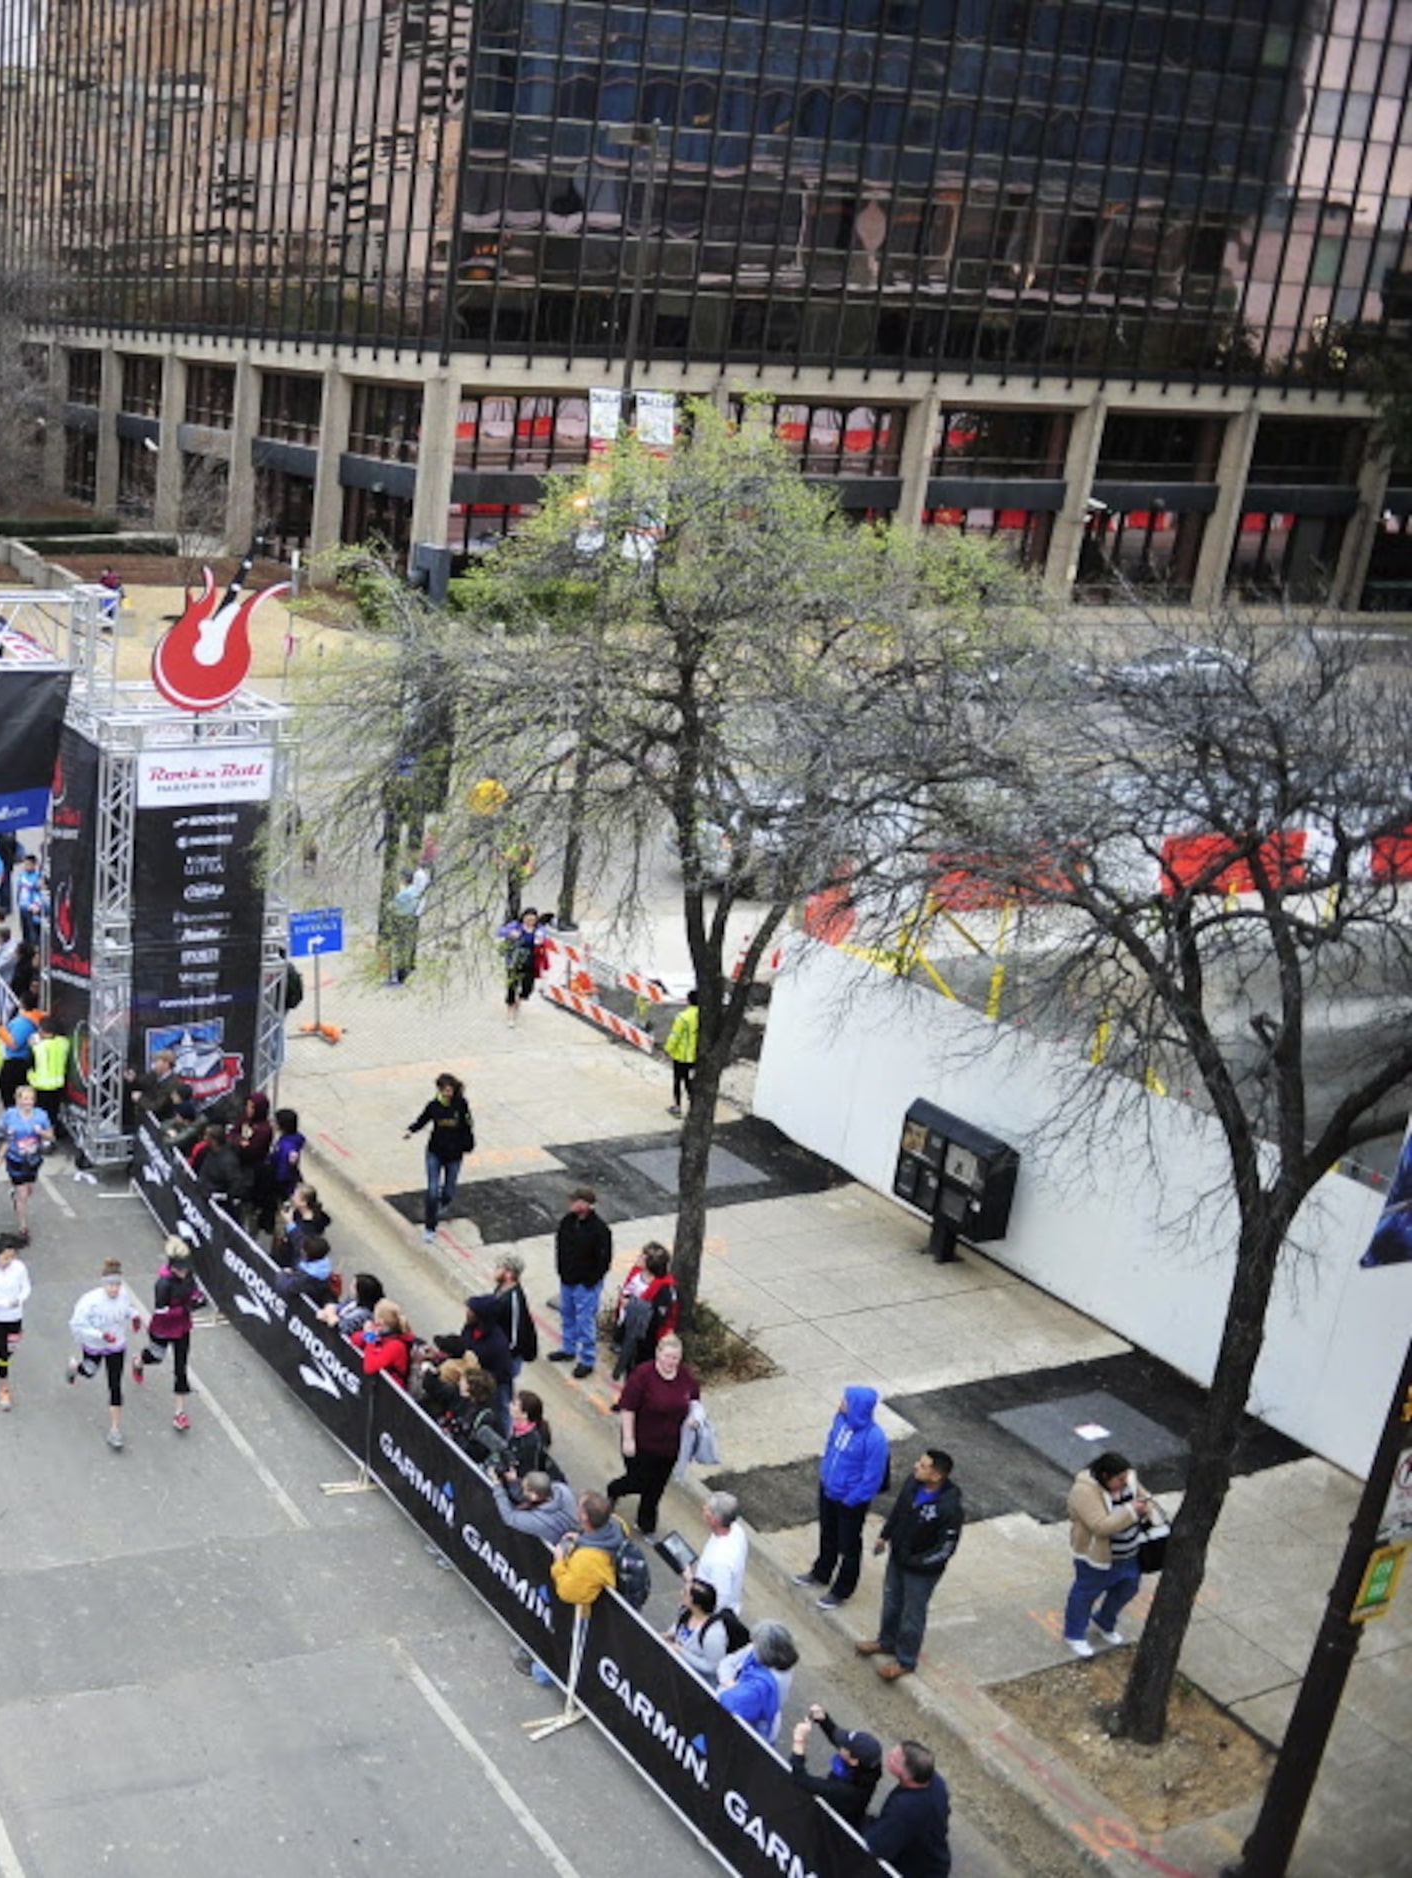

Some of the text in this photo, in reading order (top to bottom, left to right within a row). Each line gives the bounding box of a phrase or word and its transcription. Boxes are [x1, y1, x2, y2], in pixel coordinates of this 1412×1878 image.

[222, 1248, 288, 1321] BROOKS
[288, 1315, 361, 1397] BROOKS
[379, 1432, 455, 1527] GARMIN
[461, 1523, 553, 1631] GARMIN
[598, 1656, 708, 1785] GARMIN
